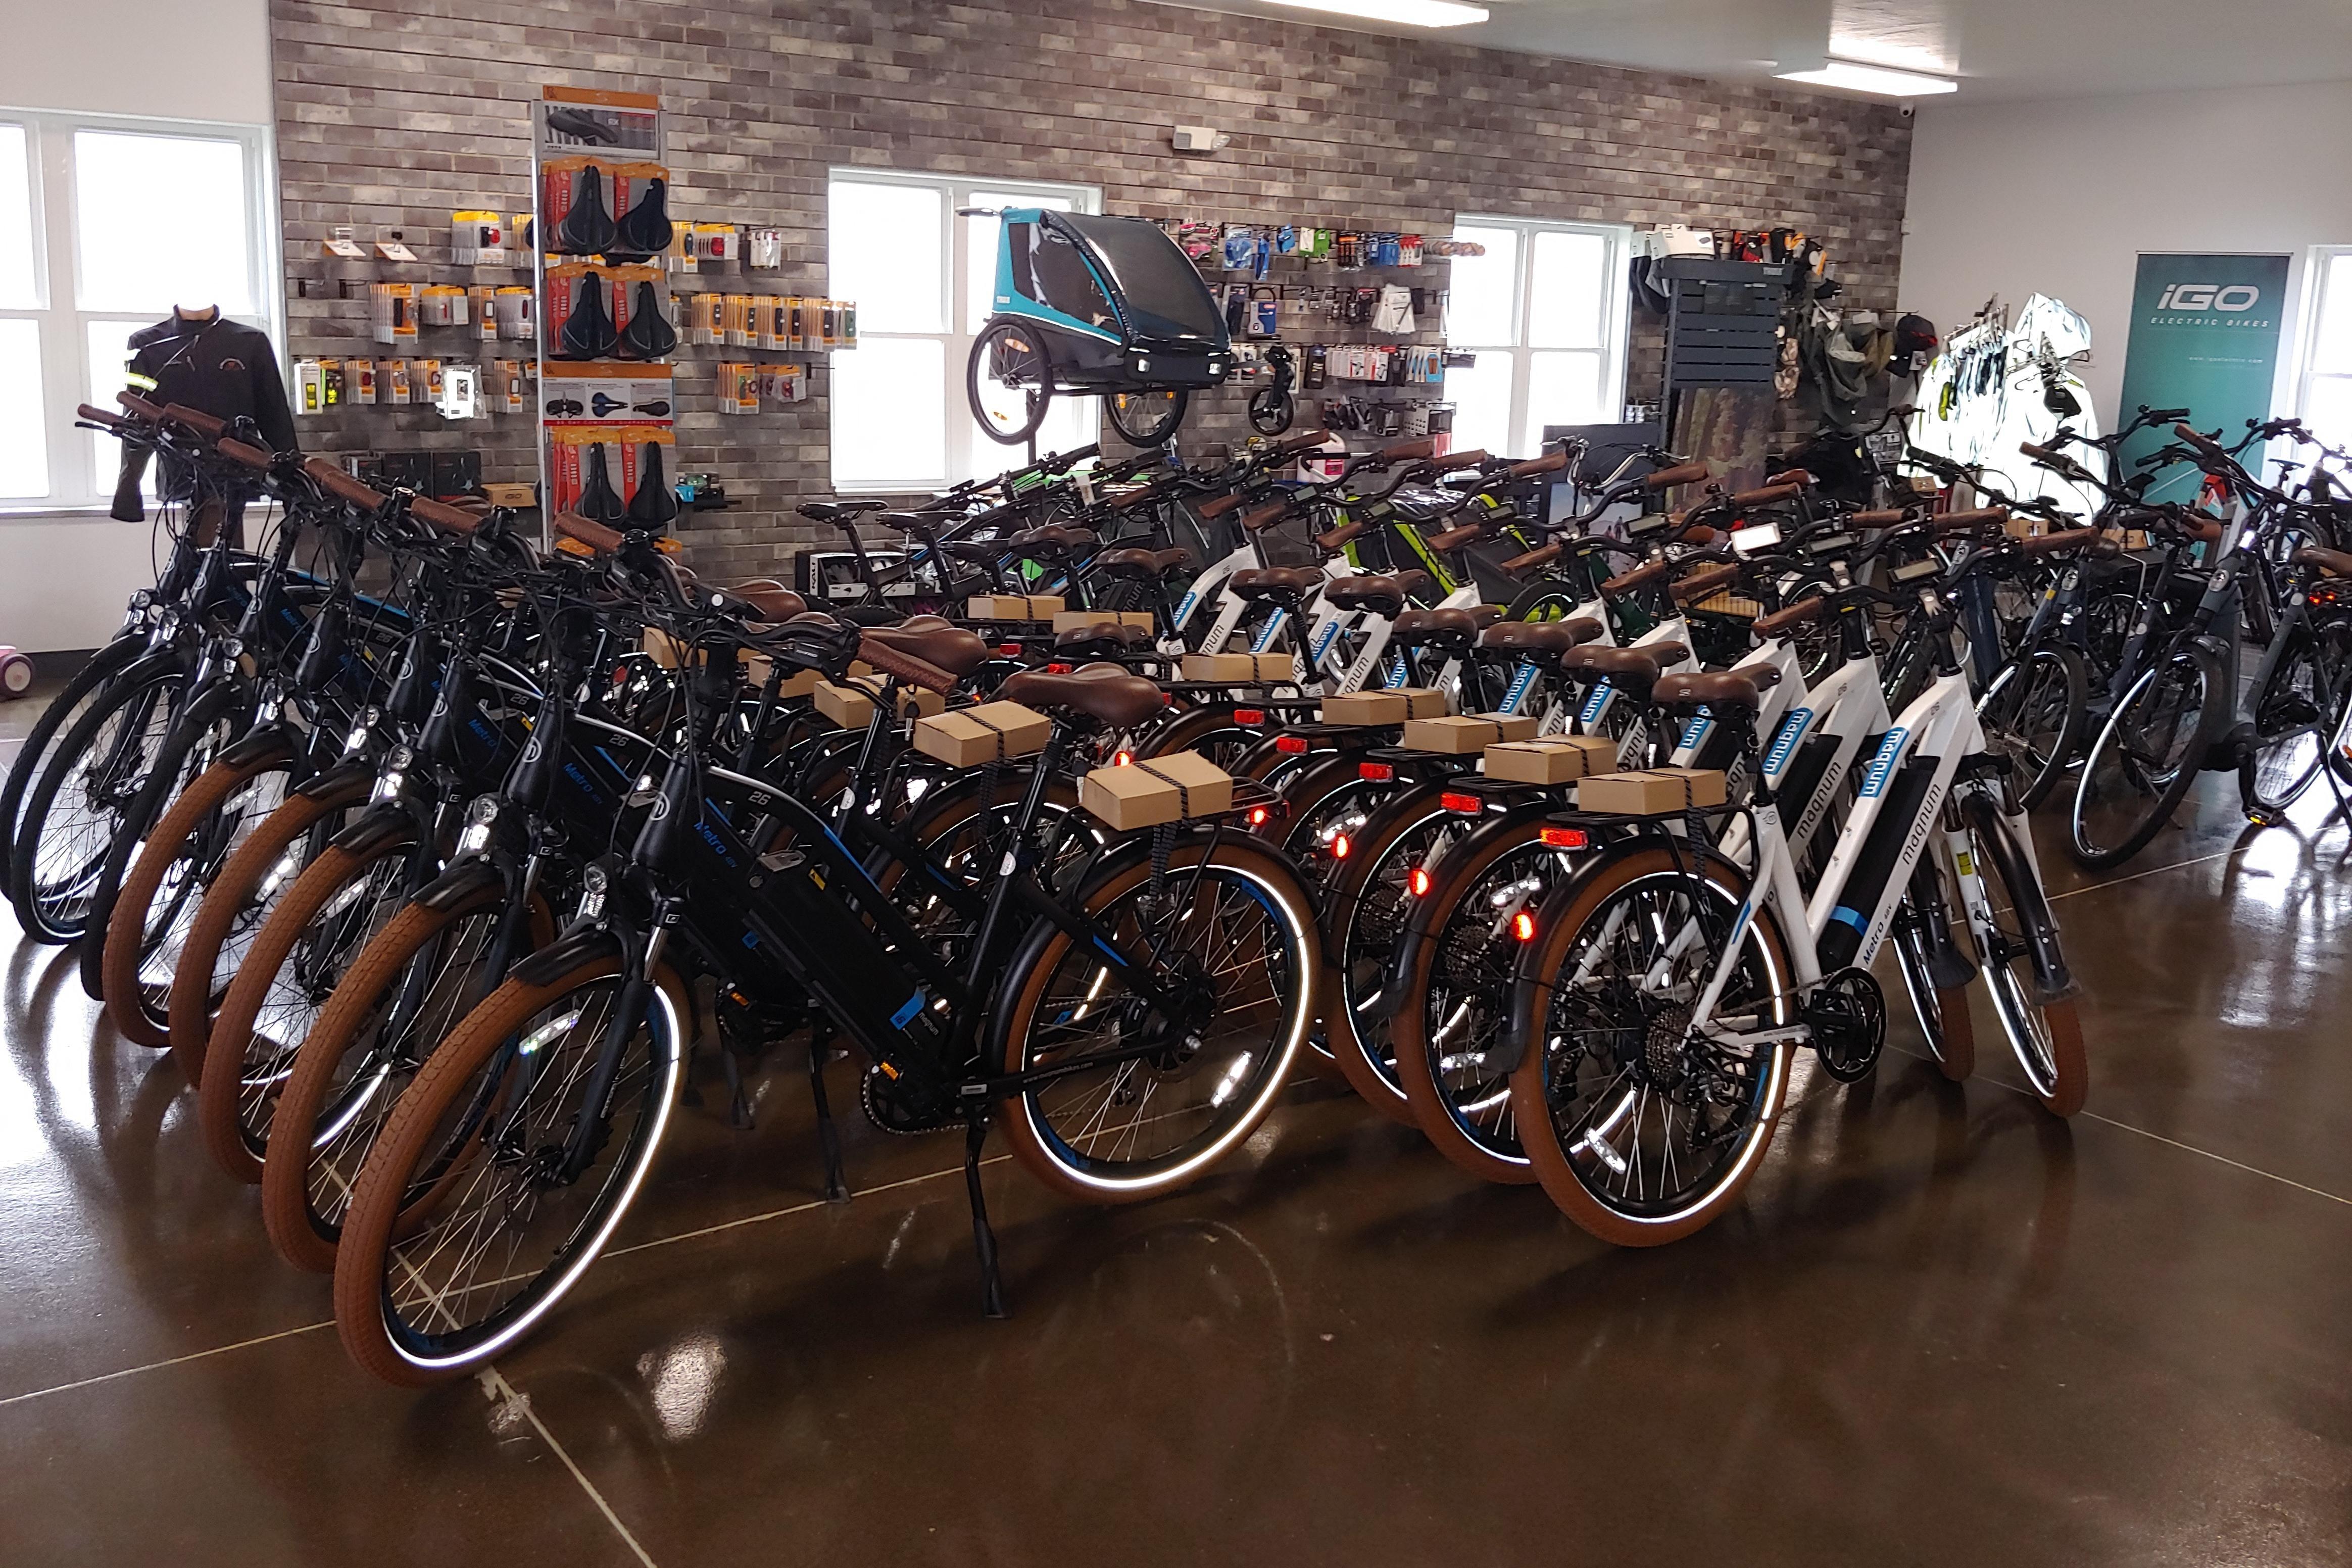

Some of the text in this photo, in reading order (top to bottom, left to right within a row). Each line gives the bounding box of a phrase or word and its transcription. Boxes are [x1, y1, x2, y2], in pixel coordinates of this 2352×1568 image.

[2157, 284, 2260, 311] iGO
[2150, 317, 2269, 328] ELECTRIC BIKES
[509, 693, 530, 706] 26
[609, 733, 630, 747] 26
[1763, 711, 1807, 772] magnum
[1863, 730, 1903, 795] magnum
[563, 762, 594, 793] Metro
[747, 791, 772, 806] 26
[1797, 761, 1841, 839] magnum
[1902, 783, 1941, 865] magnum
[1863, 921, 1884, 965] Metro
[918, 1012, 940, 1036] magnum
